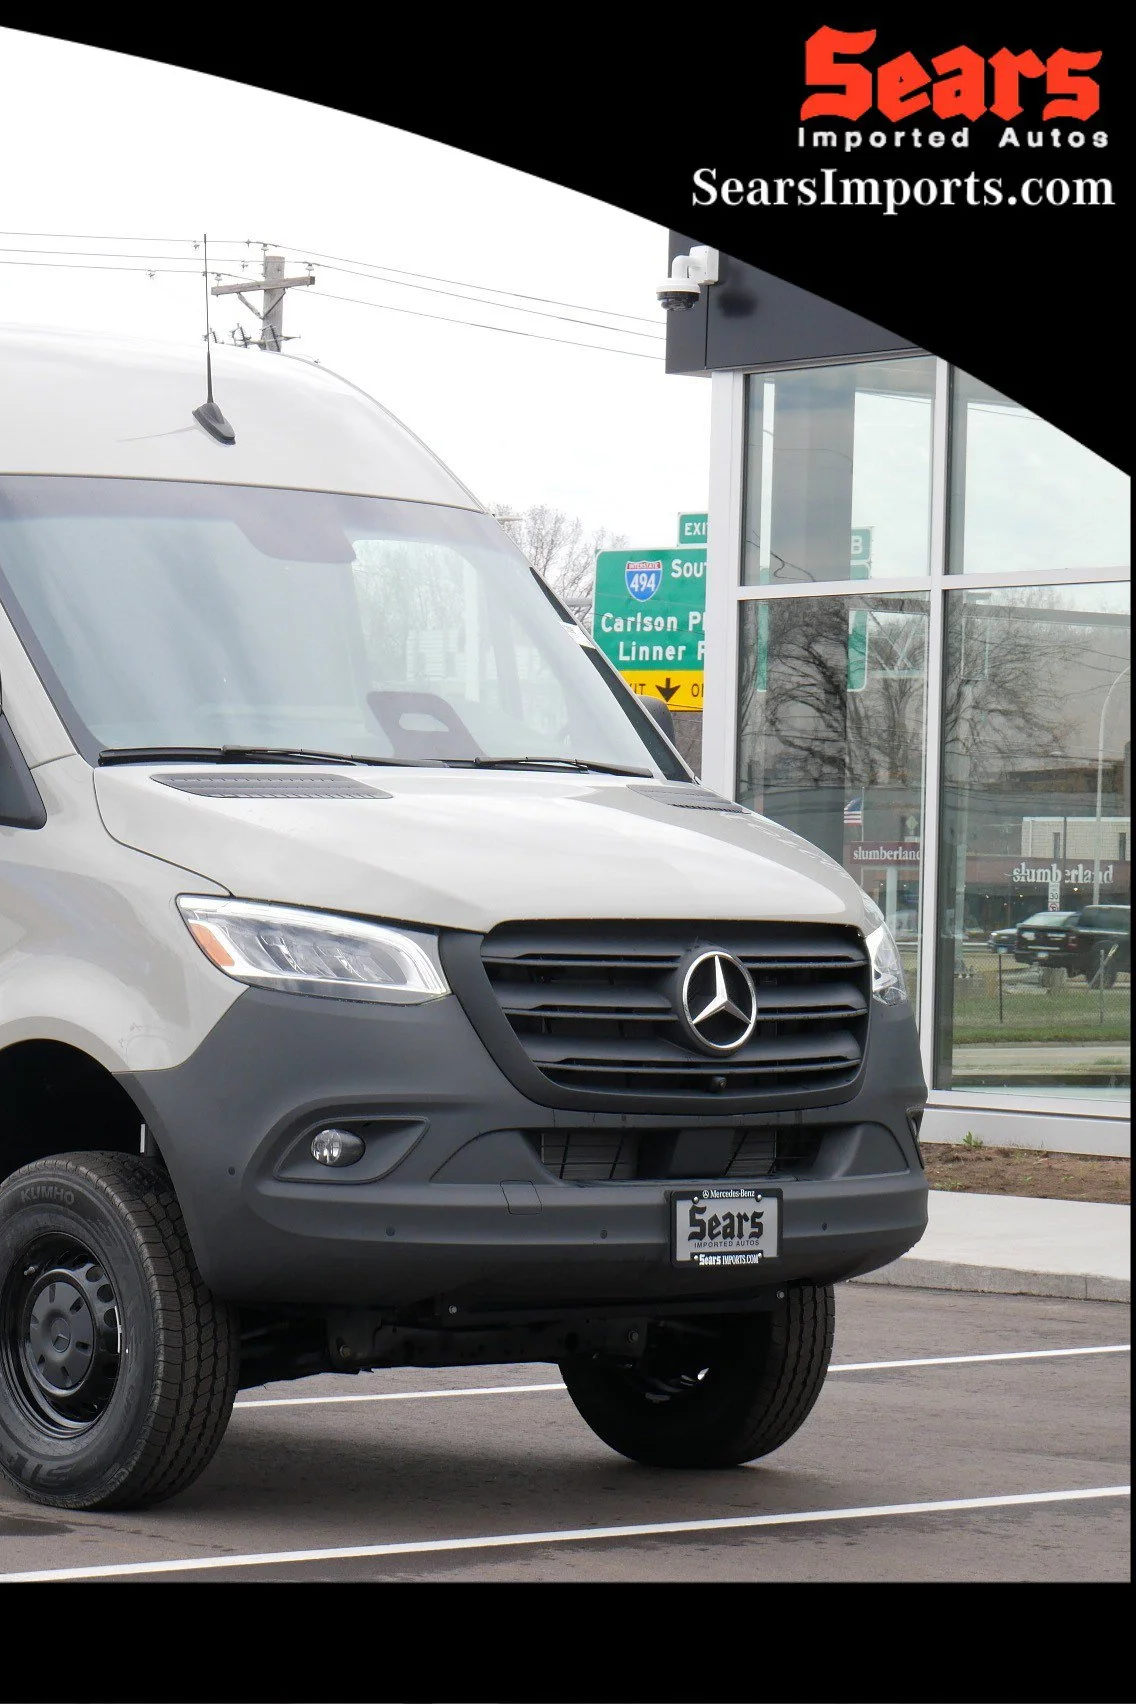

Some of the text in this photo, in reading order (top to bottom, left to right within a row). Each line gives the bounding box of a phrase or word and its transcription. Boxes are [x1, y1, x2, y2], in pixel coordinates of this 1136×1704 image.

[684, 522, 708, 536] EXI
[630, 573, 656, 592] 494
[601, 612, 678, 632] Carlson
[618, 641, 686, 661] Linner
[21, 1185, 75, 1205] KUMHO
[710, 1189, 755, 1199] Mercedes-Benz
[688, 1204, 764, 1241] Sears
[694, 1241, 733, 1249] IMPORTED
[699, 1254, 721, 1265] Sears
